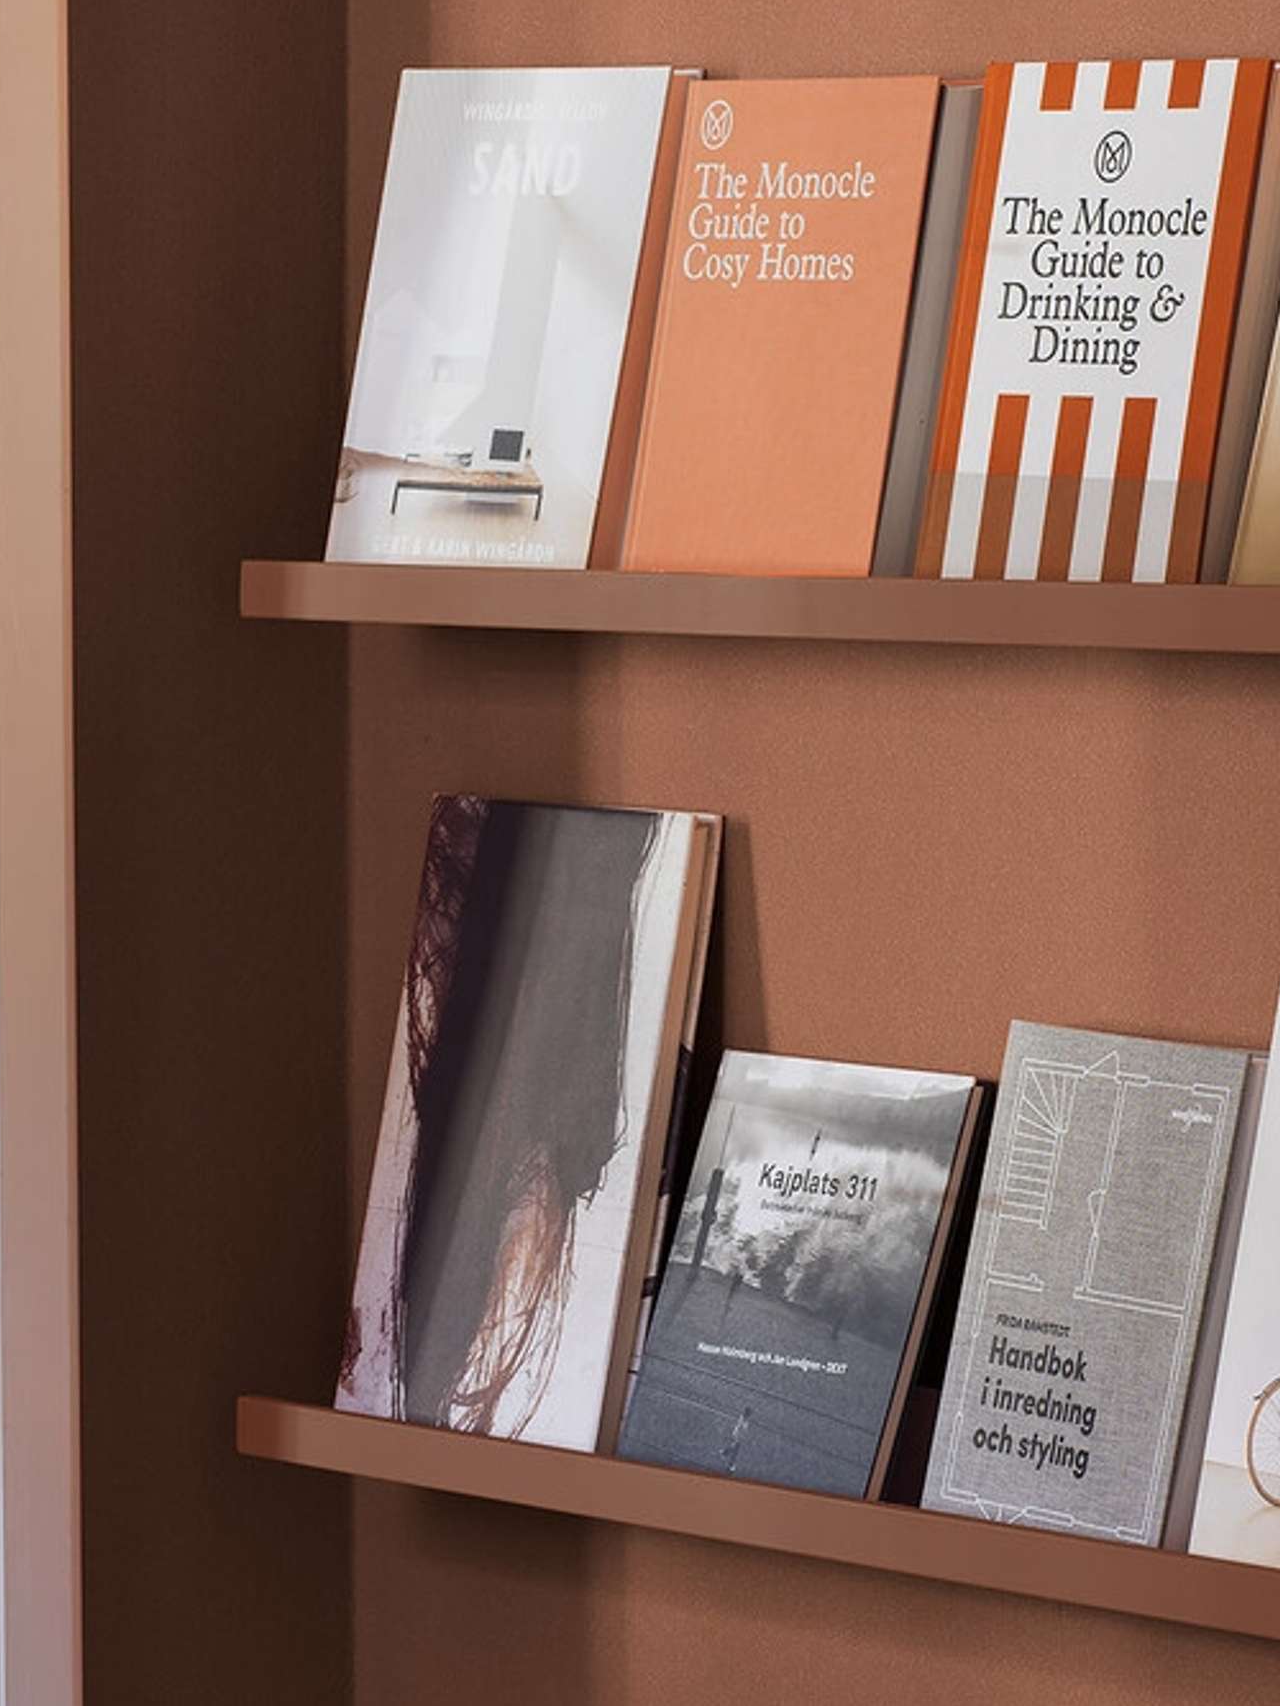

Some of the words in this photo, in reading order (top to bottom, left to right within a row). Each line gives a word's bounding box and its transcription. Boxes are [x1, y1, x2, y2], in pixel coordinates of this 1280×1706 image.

[468, 141, 581, 197] SAND
[694, 162, 748, 199] The
[756, 160, 876, 199] Monocle
[688, 202, 769, 240] Guide
[778, 211, 806, 240] to
[1003, 197, 1064, 235] The
[1071, 197, 1209, 237] Monocle
[683, 243, 750, 289] Cosy
[756, 244, 855, 281] Homes
[1031, 239, 1125, 279] Guide
[1135, 249, 1164, 280] to
[998, 281, 1141, 332] Drinking
[1150, 284, 1186, 323] &
[1029, 325, 1141, 375] Dining
[758, 1163, 841, 1198] Kajplats
[845, 1174, 878, 1202] 311
[989, 1335, 1088, 1382] Handbok
[981, 1376, 990, 1406] i
[992, 1378, 1097, 1436] inredning
[972, 1423, 1013, 1454] och
[1018, 1432, 1090, 1480] styling
